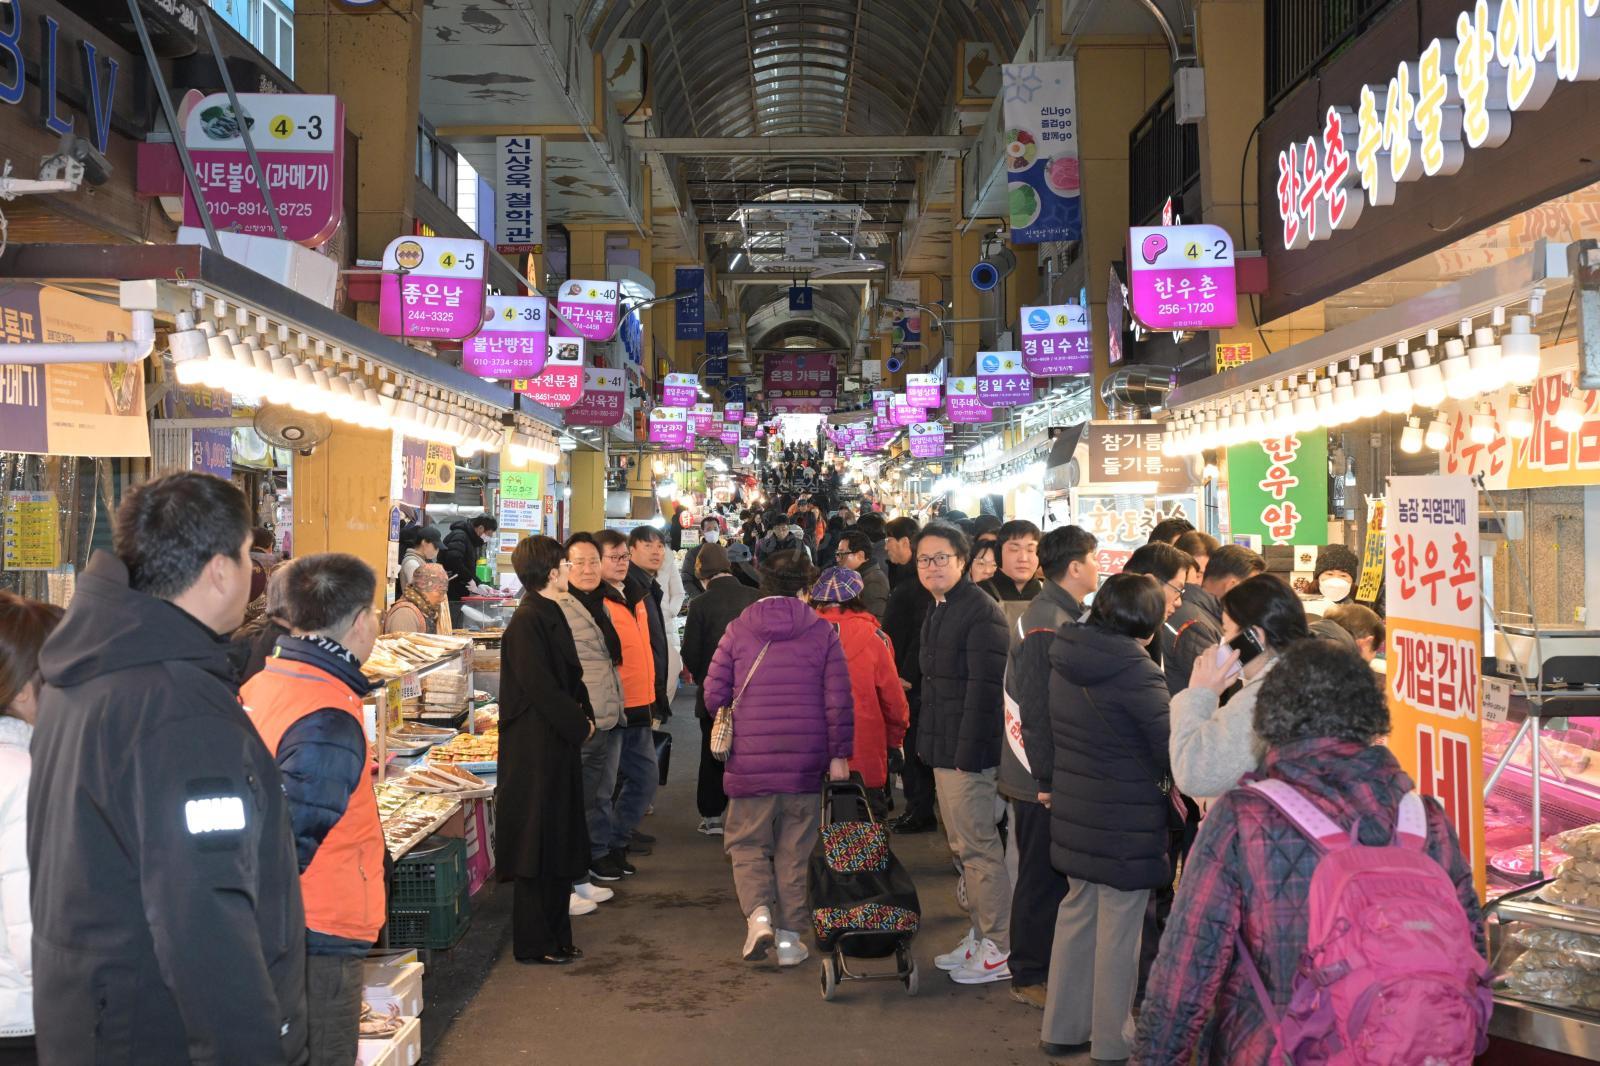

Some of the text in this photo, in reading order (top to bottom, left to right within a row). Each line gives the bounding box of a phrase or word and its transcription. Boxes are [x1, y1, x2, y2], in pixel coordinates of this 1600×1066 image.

[1041, 106, 1071, 117] 신나go
[1041, 118, 1072, 129] 즐겁go
[1277, 0, 1600, 250] 한우촌 축산물 할인매
[1041, 131, 1073, 142] 함께go
[1187, 240, 1228, 260] 4-2
[443, 253, 475, 271] 4-5
[402, 283, 464, 307] 좋은날
[1154, 274, 1219, 300] 한우촌
[408, 310, 454, 322] 244-3325
[505, 308, 541, 321] 4-38
[560, 305, 614, 324] 대구식육점
[1158, 302, 1215, 315] 256-1720
[473, 336, 535, 354] 불난빵집
[1024, 337, 1090, 356] 경일수산
[979, 378, 1031, 392] 경일수산
[1101, 432, 1163, 452] 참기름
[1101, 456, 1164, 476] 들기름
[1259, 432, 1301, 546] 한우암
[1399, 498, 1419, 524] 농장
[1422, 498, 1467, 526] 직영판매
[1391, 531, 1476, 612] 한우촌
[1395, 635, 1477, 714] 개업감사
